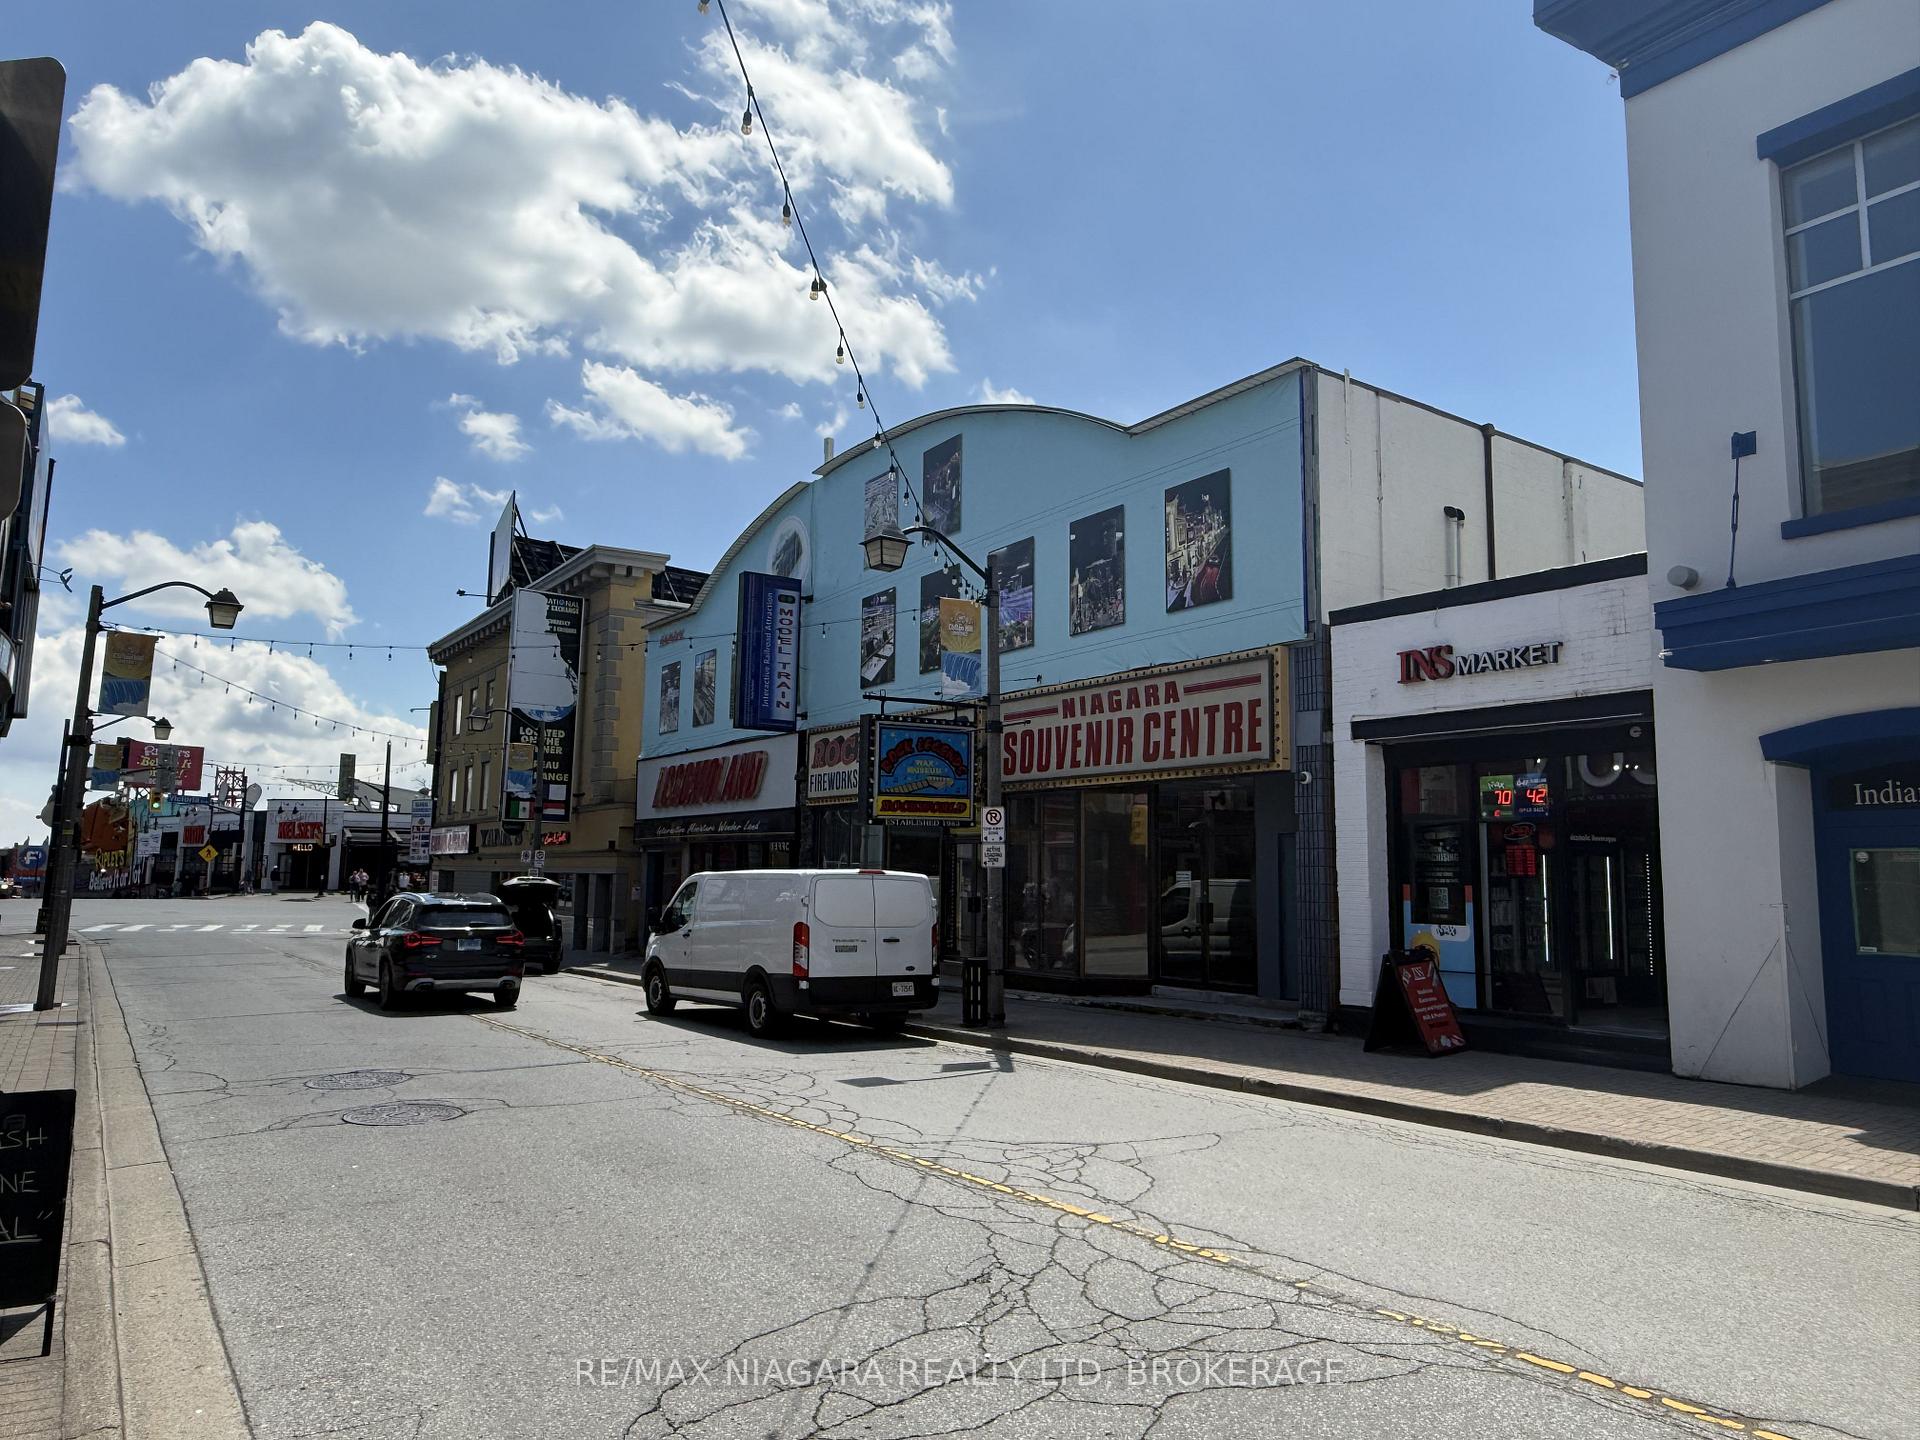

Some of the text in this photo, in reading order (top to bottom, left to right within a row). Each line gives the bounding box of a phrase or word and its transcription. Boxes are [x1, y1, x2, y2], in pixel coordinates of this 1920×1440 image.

[546, 597, 580, 609] ATIONAL
[763, 591, 774, 631] Attraction
[762, 631, 773, 665] Railroad
[778, 608, 793, 656] MODEL
[1396, 641, 1563, 685] INS MARKET
[776, 661, 792, 710] TRAIN
[1061, 680, 1180, 719] NIAGARA
[1003, 698, 1263, 777] SOUVENIR CENTRE
[809, 768, 858, 793] FIREWORKS
[1494, 789, 1512, 805] 70
[1526, 788, 1547, 804] 42
[885, 817, 940, 827] ESTABLISHED
[292, 843, 314, 852] HELLO
